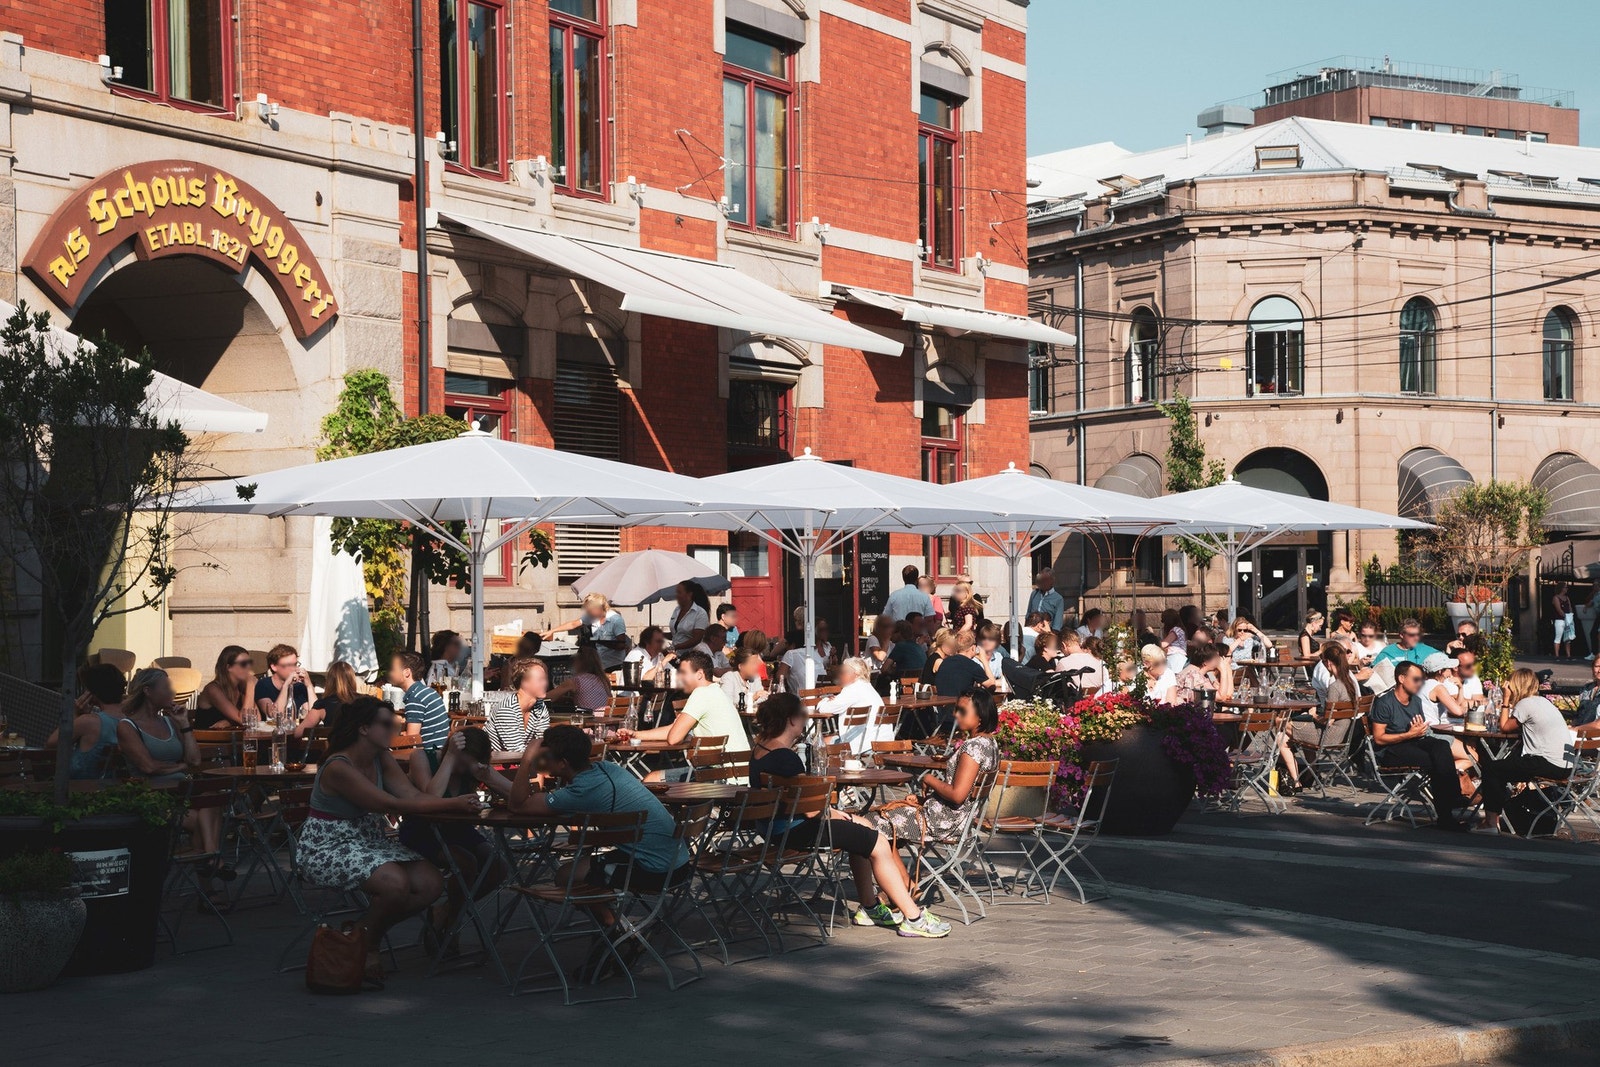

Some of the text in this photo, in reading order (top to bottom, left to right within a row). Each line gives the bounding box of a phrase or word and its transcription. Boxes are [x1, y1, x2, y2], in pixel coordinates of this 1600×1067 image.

[48, 170, 333, 319] A/S Schous Bryggeri
